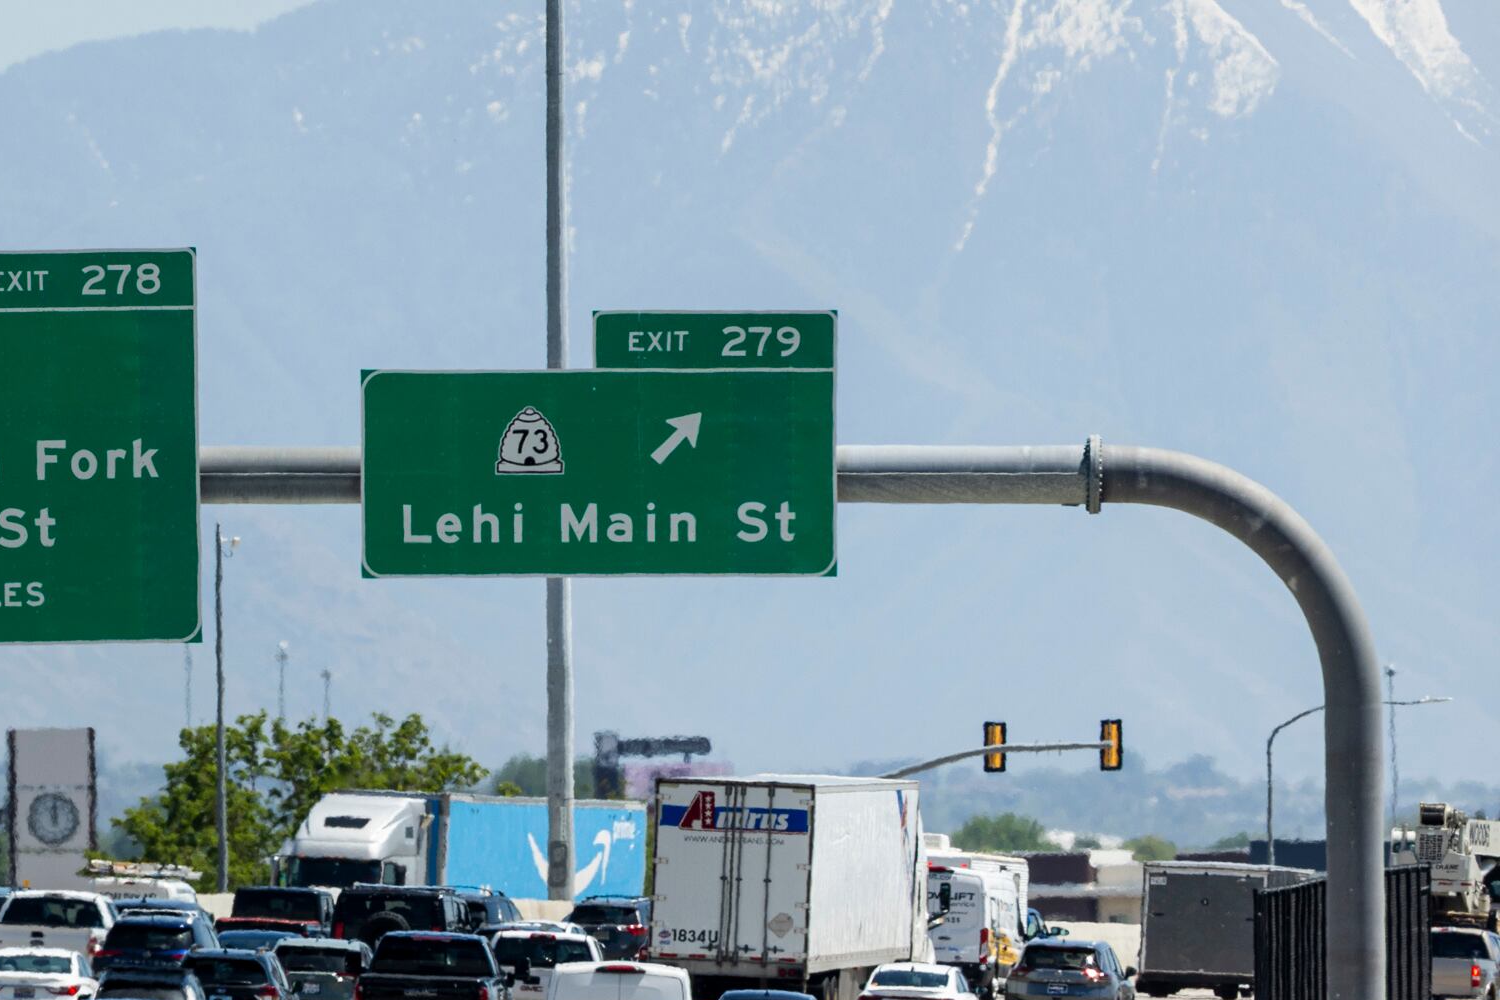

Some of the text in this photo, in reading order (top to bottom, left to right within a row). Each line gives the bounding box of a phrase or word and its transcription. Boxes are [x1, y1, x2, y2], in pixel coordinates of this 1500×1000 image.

[81, 263, 161, 296] 278
[628, 325, 801, 357] EXIT 279
[512, 429, 549, 455] 73
[36, 438, 160, 481] Fork
[403, 501, 797, 544] Lehi Main St
[672, 928, 718, 943] 1834U
